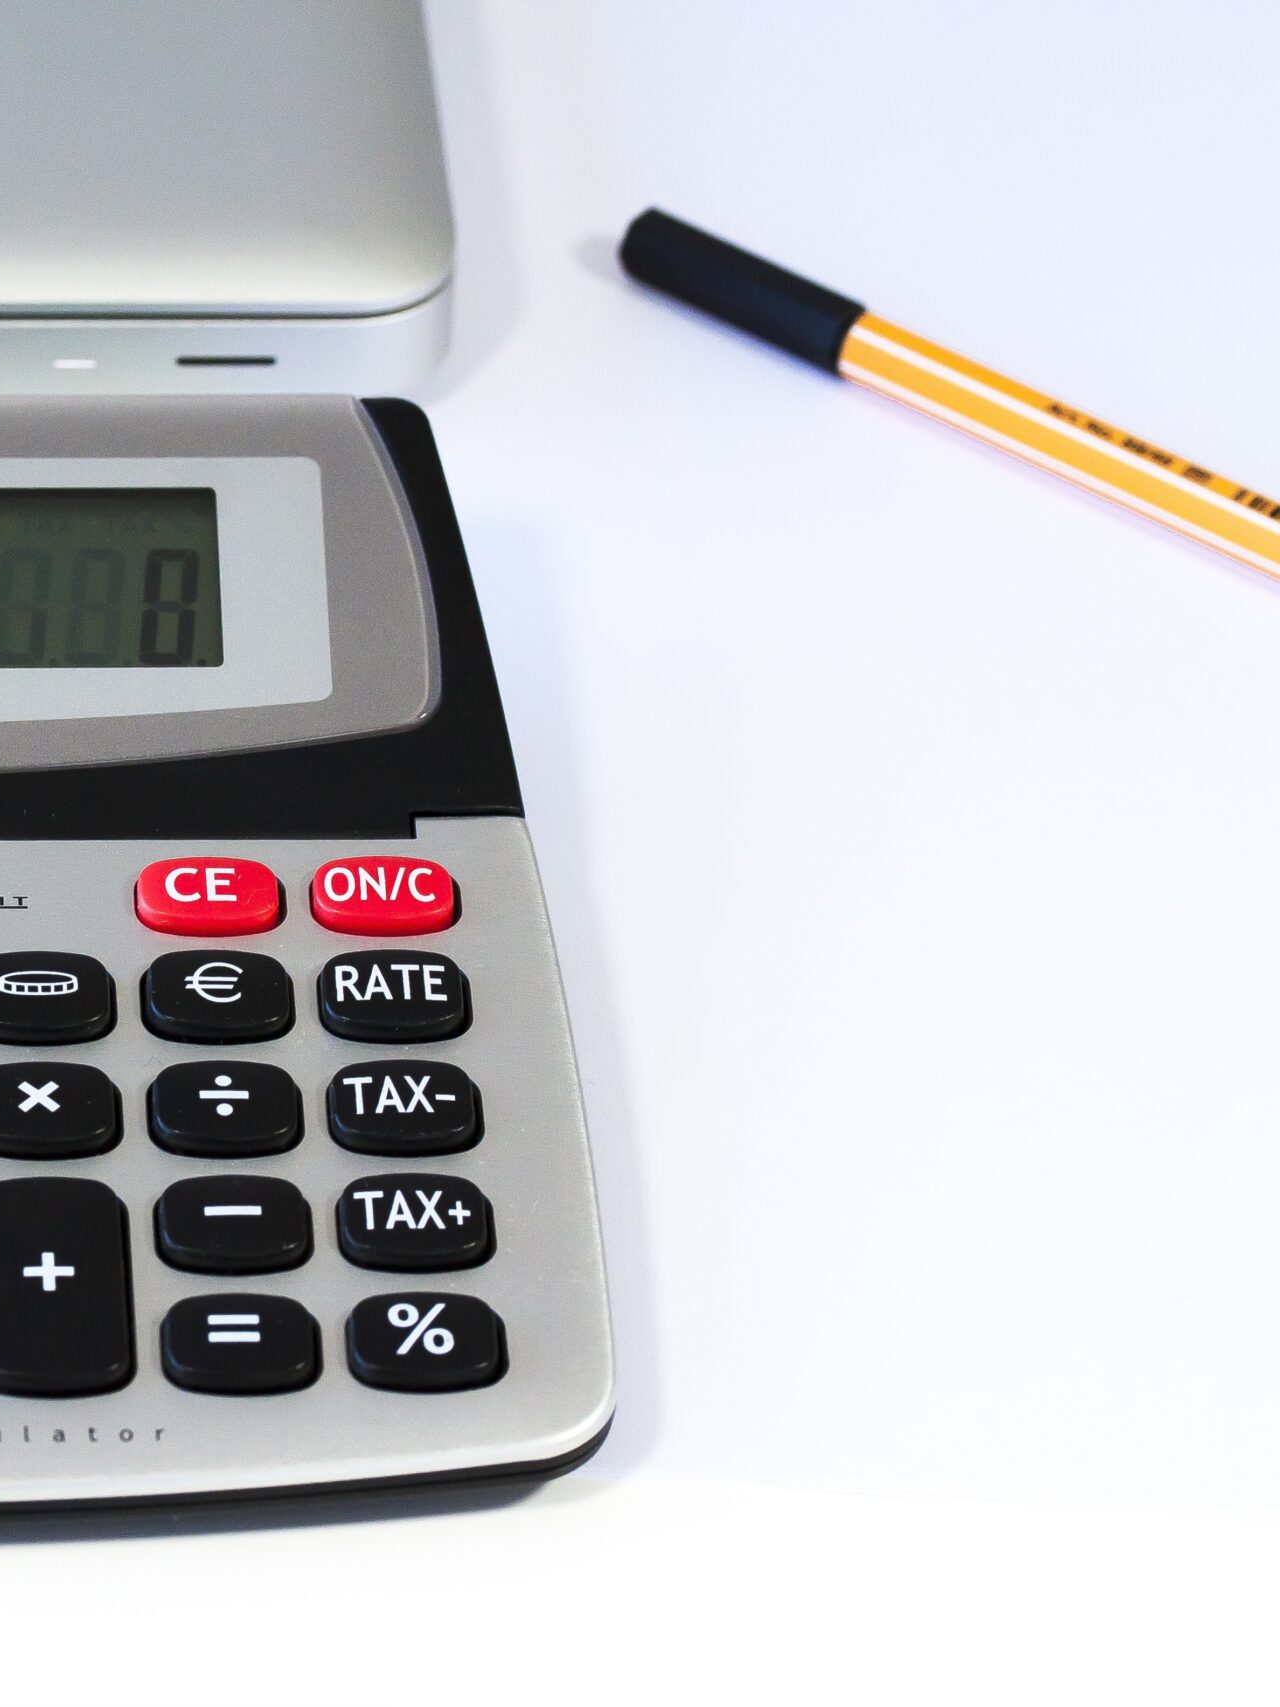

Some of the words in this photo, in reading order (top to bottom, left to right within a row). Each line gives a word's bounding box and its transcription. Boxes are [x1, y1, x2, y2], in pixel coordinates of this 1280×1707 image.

[164, 866, 238, 903] CE
[322, 865, 438, 903] ON/C
[184, 961, 243, 1003] €
[334, 964, 448, 1002] RATE
[342, 1075, 457, 1115] TAX-
[353, 1189, 472, 1231] TAX+
[23, 1251, 75, 1292] +
[207, 1313, 261, 1343] =
[387, 1302, 455, 1356] %
